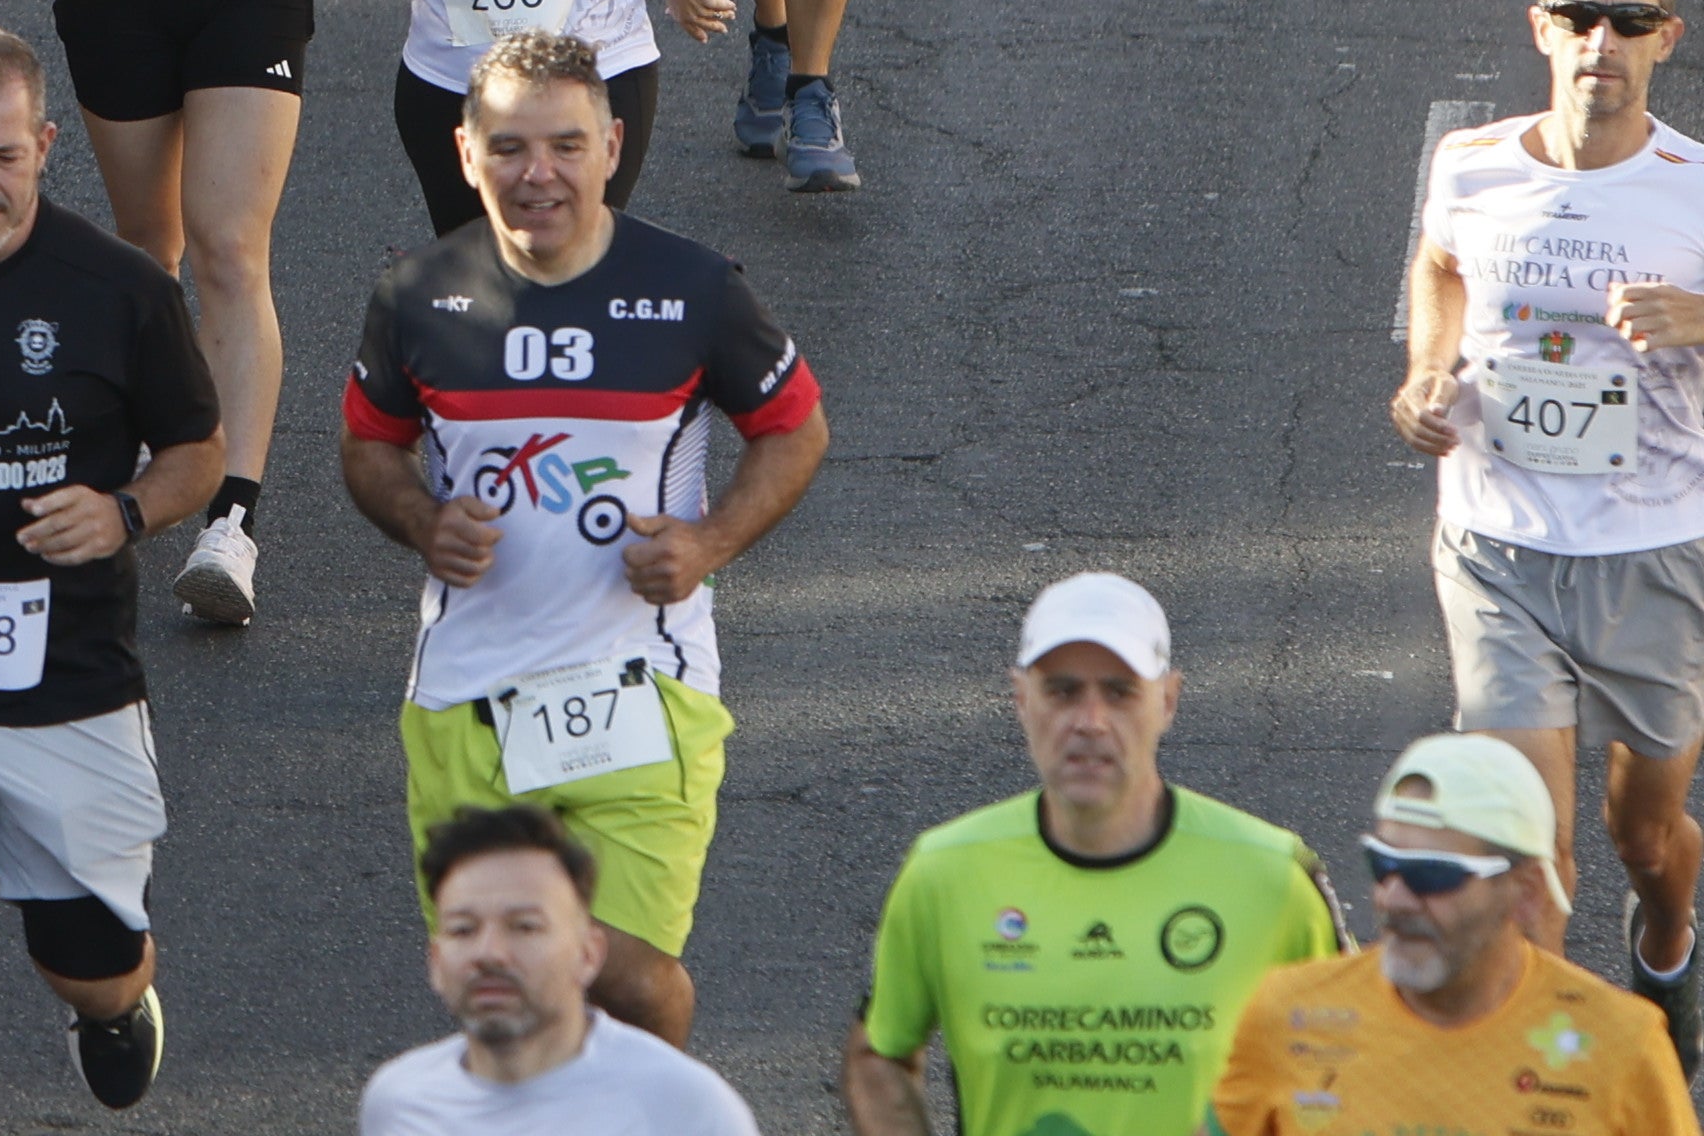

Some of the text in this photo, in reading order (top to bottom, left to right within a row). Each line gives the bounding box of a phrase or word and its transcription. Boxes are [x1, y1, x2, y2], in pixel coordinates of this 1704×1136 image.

[1525, 238, 1630, 263] CARRERA
[608, 297, 685, 322] C.G.M
[504, 325, 595, 381] 03
[1507, 395, 1599, 439] 407
[16, 440, 71, 456] MILITAR
[533, 688, 620, 744] 187
[983, 1004, 1216, 1031] CORRECAMINOS
[1004, 1038, 1185, 1065] CARBAJOSA
[1032, 1071, 1158, 1093] SALAMANCA
